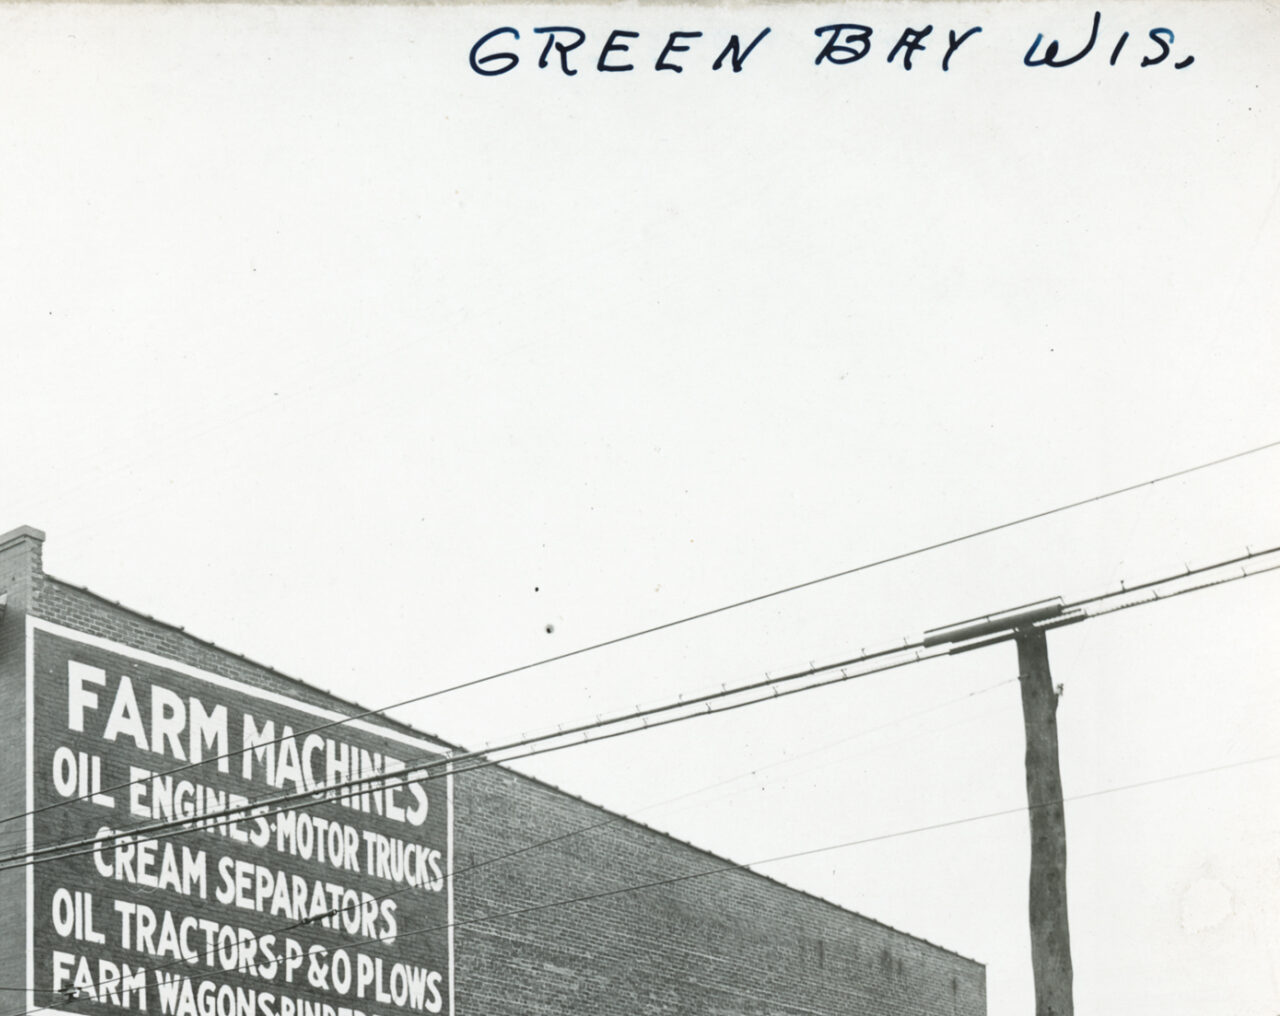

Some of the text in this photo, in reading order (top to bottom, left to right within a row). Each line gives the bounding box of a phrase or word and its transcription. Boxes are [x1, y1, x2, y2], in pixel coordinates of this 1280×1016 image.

[468, 10, 1197, 77] GREEN BAY WIS.
[67, 659, 429, 827] FARM MACHINES
[52, 746, 115, 808] OIL
[362, 829, 444, 893] TRUCKS
[92, 826, 398, 945] CREAM SEPARATORS
[51, 887, 106, 945] OIL
[114, 900, 279, 980] TRACTORS
[307, 944, 330, 990] &
[331, 949, 353, 995] O
[356, 952, 443, 1013] PLOWS
[52, 950, 147, 1012] FARM
